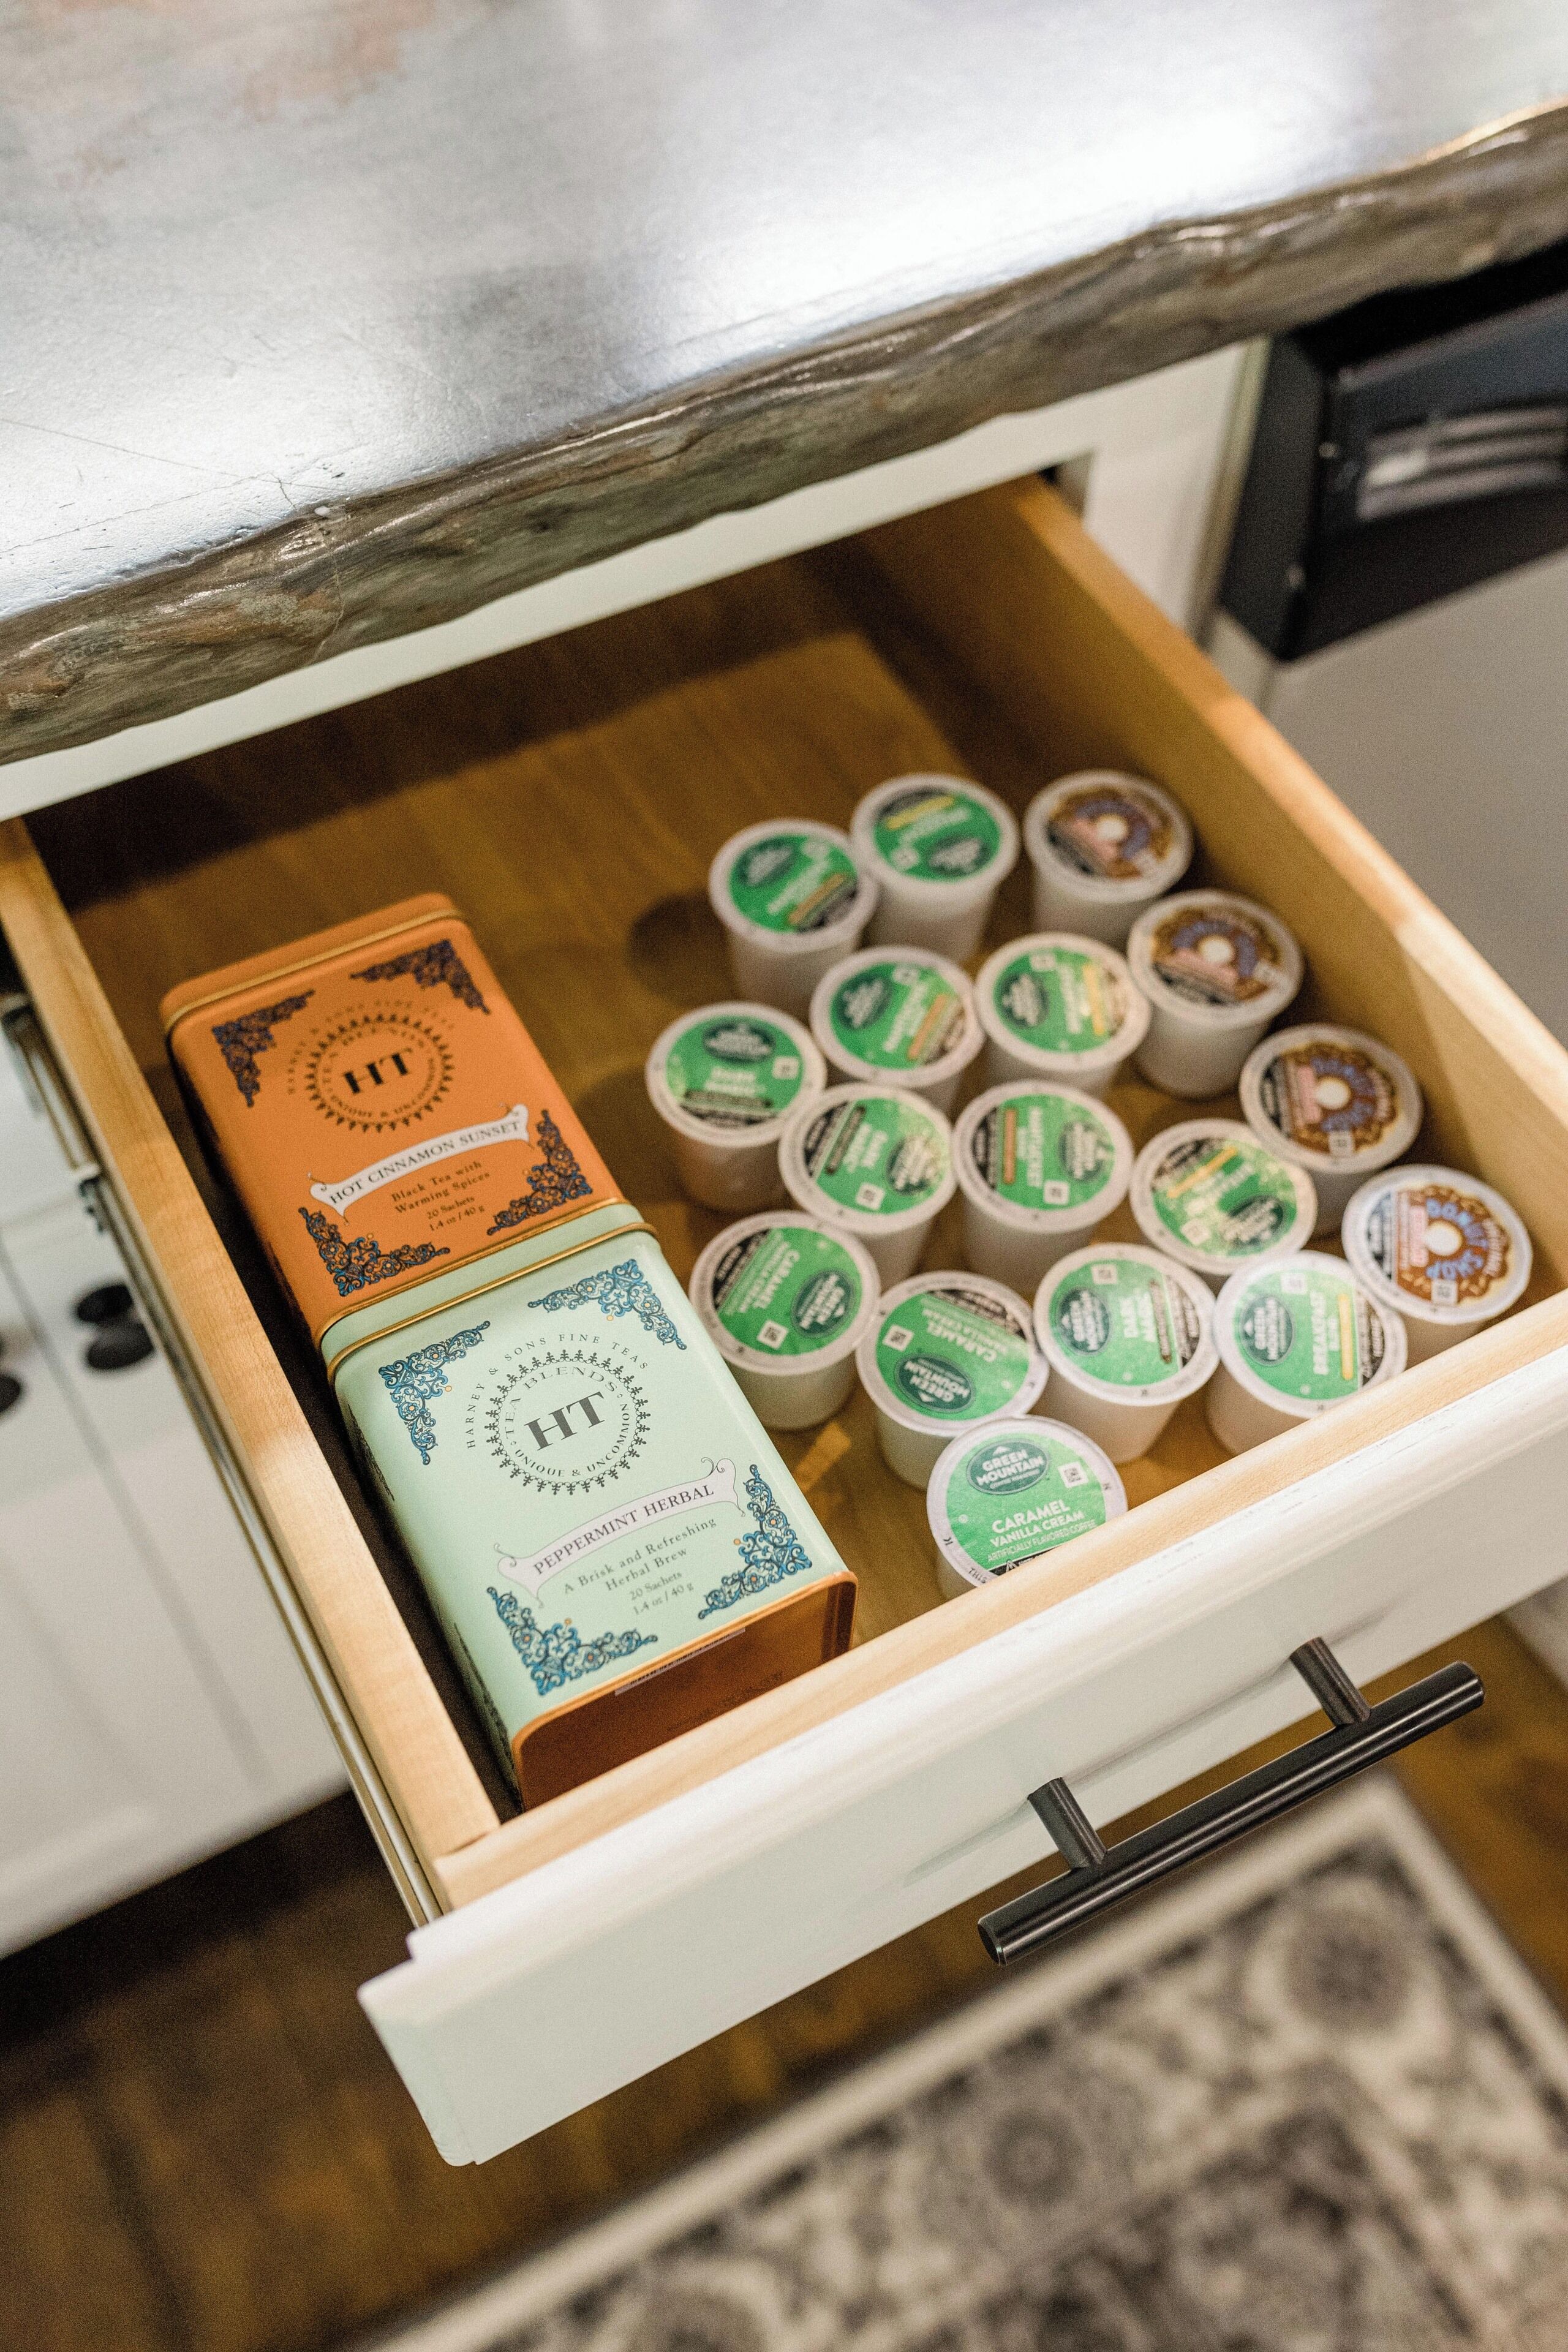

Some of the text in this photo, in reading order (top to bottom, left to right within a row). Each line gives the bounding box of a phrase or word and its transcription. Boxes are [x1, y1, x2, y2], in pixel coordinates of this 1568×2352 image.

[342, 1046, 413, 1095] HT
[329, 1120, 520, 1204] HOT CINNAMON SUNSET
[390, 1161, 481, 1202] Black Tea with
[394, 1172, 490, 1214] Warming Spices
[440, 1196, 475, 1214] Sachets
[928, 1321, 997, 1362] CARAMEL
[466, 1383, 484, 1449] HARNEY
[503, 1338, 546, 1362] SONS
[559, 1333, 600, 1344] FINE
[611, 1341, 649, 1370] TEAS
[904, 1360, 970, 1398] MOUNTAIN
[910, 1375, 954, 1402] GREEN
[505, 1365, 617, 1439] TEA BLENDS
[524, 1391, 605, 1451] HT
[514, 1449, 565, 1477] UNIQUE
[586, 1403, 630, 1472] UNCOMMON
[982, 1449, 1028, 1471] GREEN
[976, 1456, 1044, 1485] MOUNTAIN
[532, 1485, 715, 1575] PEPPERMINT HERBAL
[990, 1511, 1085, 1547] VANILLA CREAM
[992, 1499, 1069, 1534] CARAMEL
[564, 1518, 717, 1594] A Brisk and Refreshing
[605, 1548, 687, 1593] Herbal Brew
[988, 1541, 1031, 1561] ARTIFICIALLY
[629, 1571, 682, 1601] 20 Sachets
[968, 1567, 987, 1584] THIS
[633, 1602, 649, 1615] 1.4
[671, 1583, 685, 1596] 40
